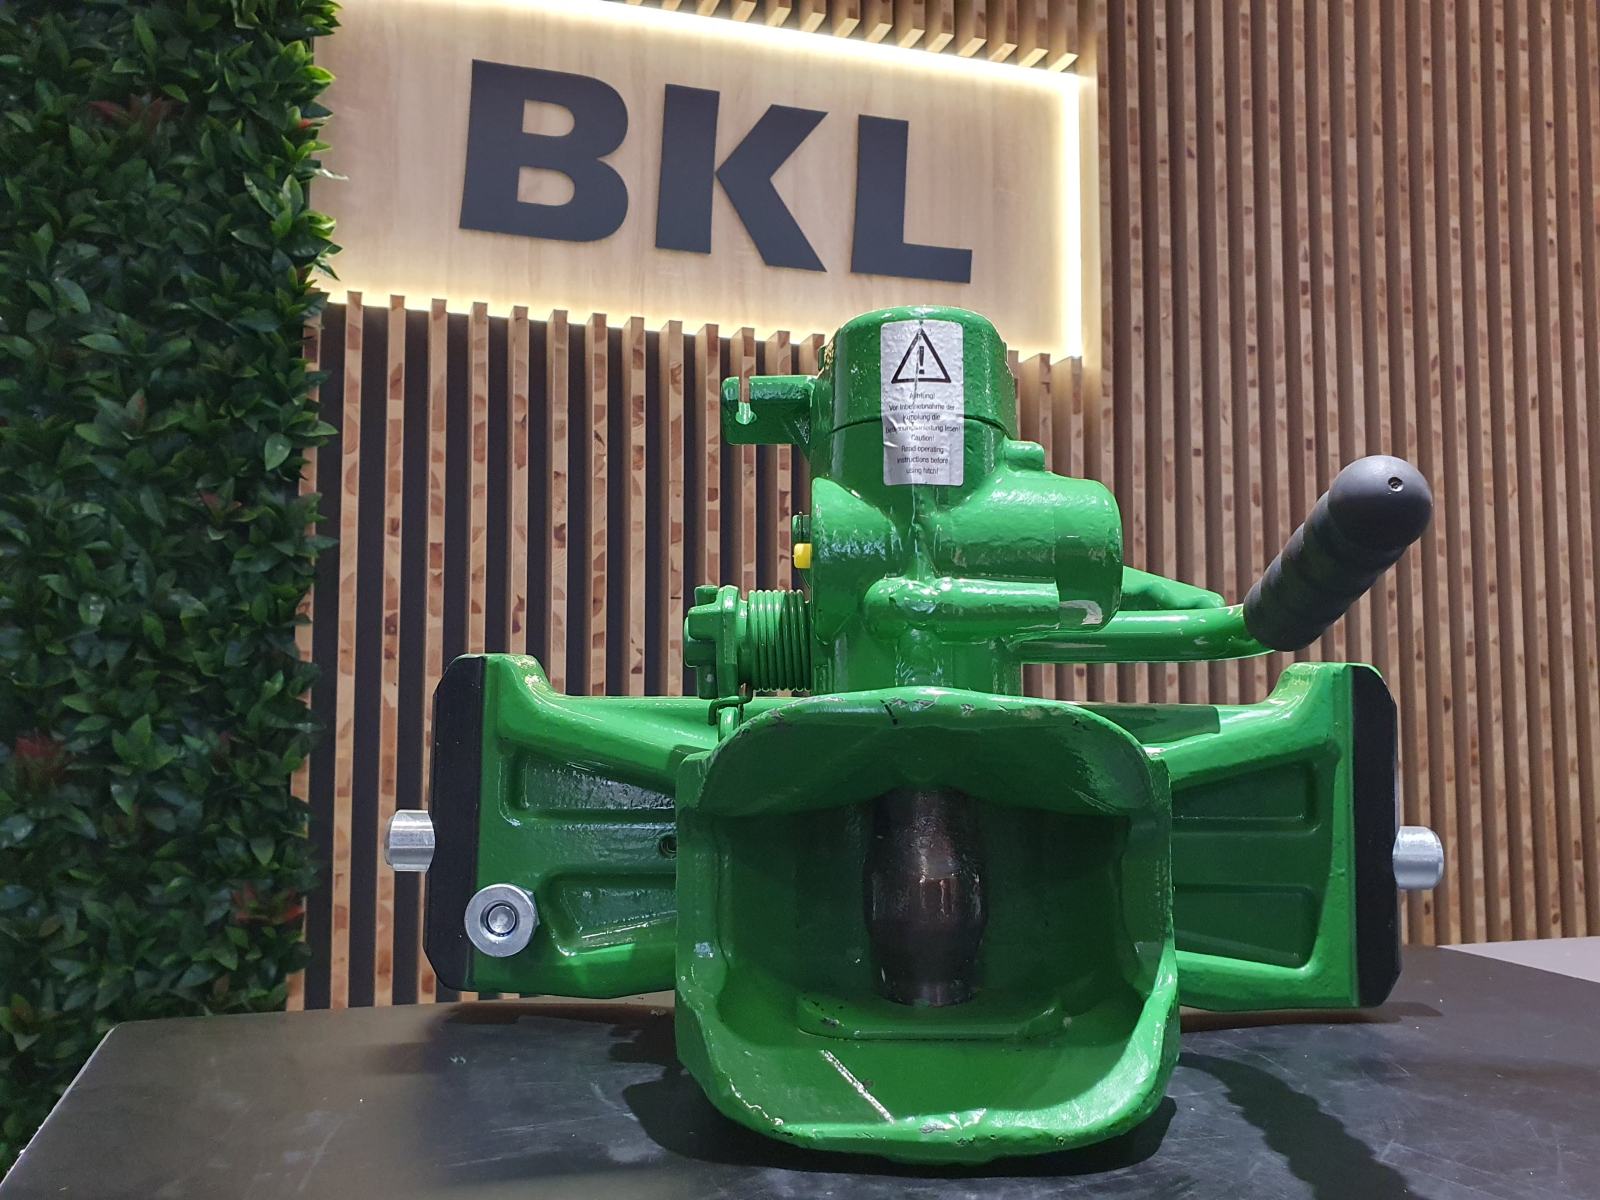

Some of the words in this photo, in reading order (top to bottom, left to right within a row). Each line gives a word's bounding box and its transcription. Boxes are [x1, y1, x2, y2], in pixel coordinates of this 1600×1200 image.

[459, 59, 973, 284] BKL
[888, 403, 898, 411] Vor
[946, 403, 955, 411] der
[910, 434, 935, 442] Caution!
[917, 446, 944, 454] operating
[922, 467, 939, 475] hitch!
